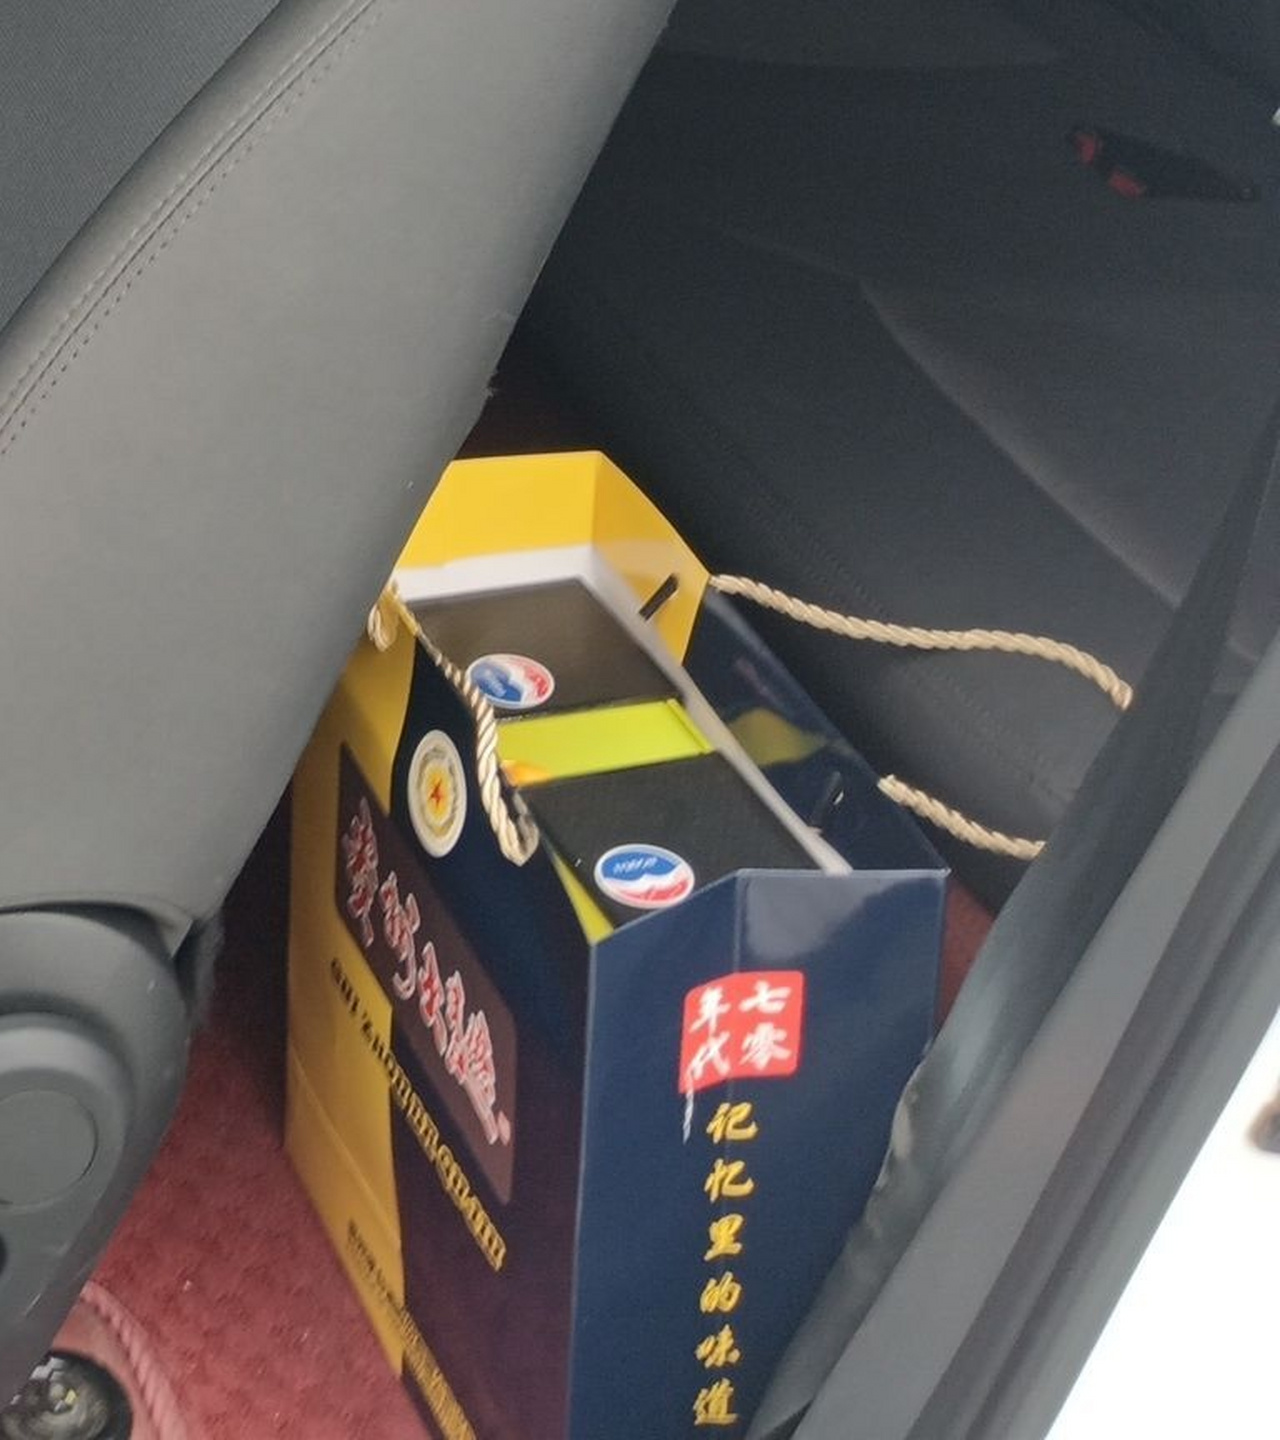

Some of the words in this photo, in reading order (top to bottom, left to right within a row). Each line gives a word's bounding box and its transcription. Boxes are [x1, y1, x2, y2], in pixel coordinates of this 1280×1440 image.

[693, 1101, 759, 1426] 记忆里的味道
